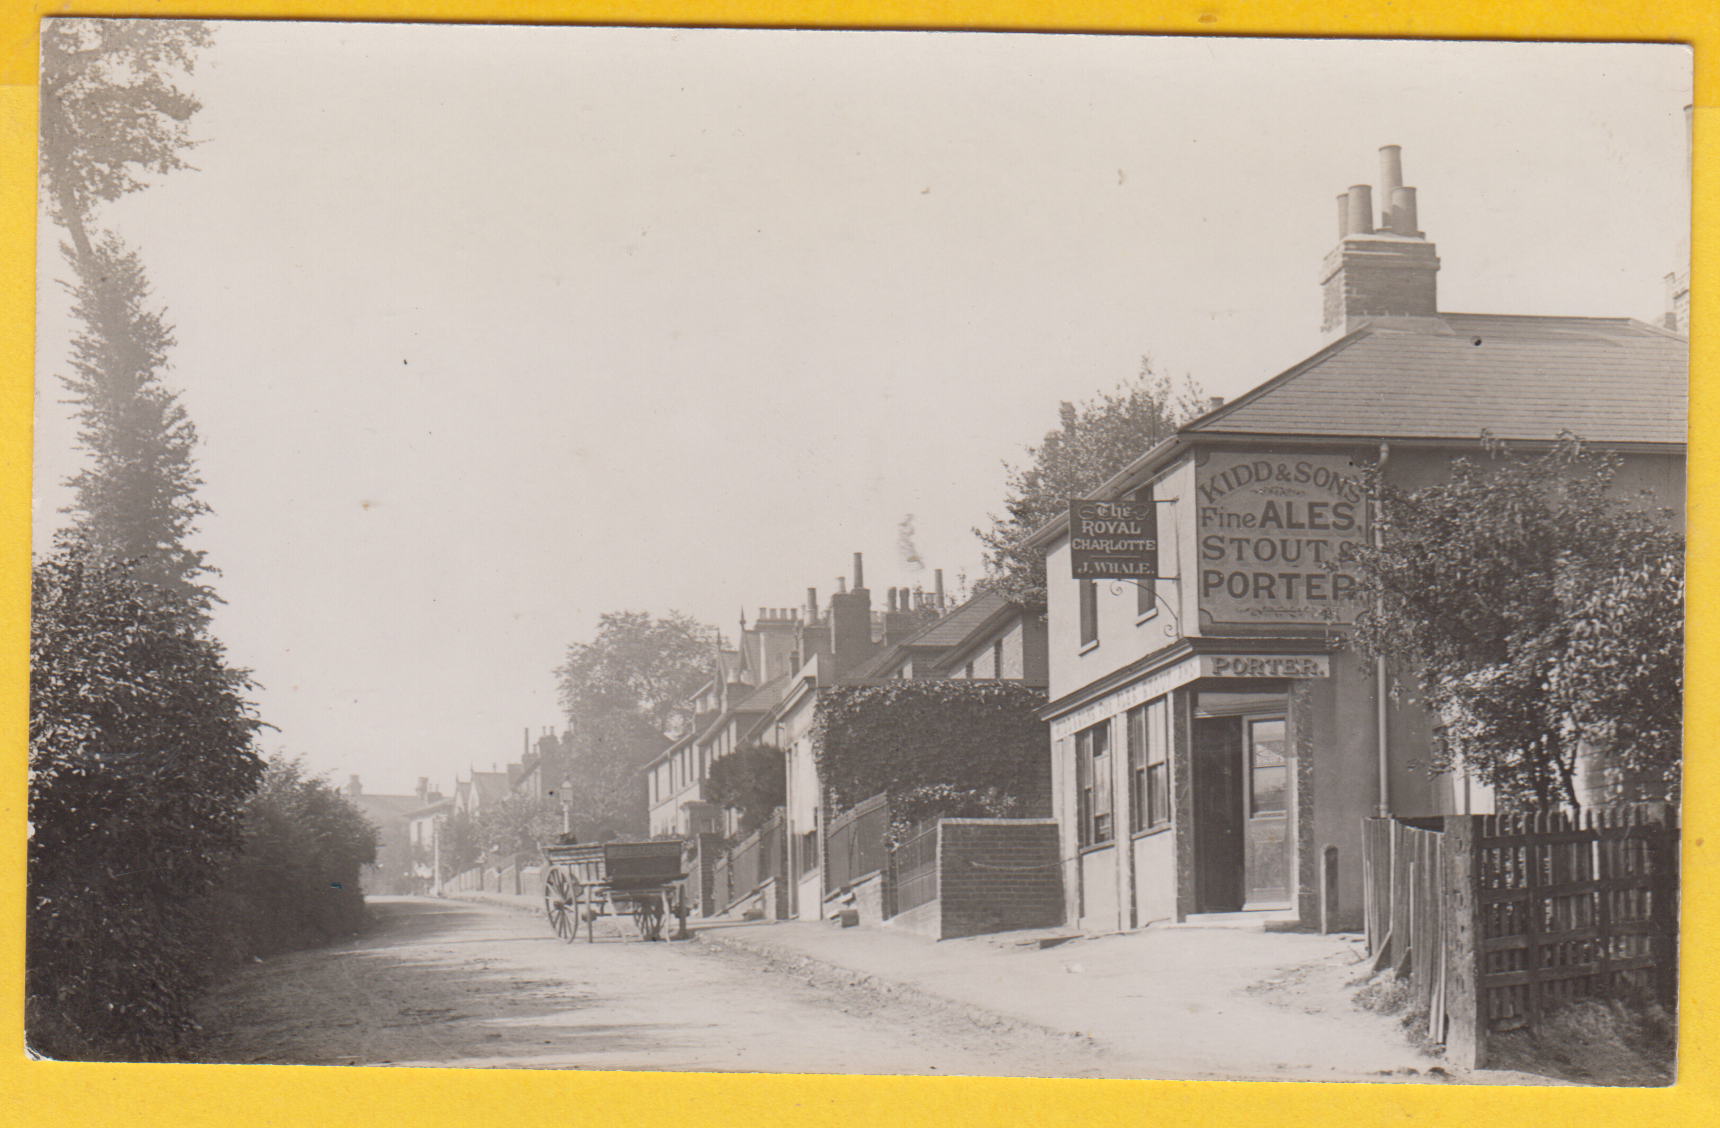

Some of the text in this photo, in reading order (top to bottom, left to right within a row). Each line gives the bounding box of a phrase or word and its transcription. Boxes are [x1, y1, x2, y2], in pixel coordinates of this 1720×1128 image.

[1198, 461, 1272, 504] KIDD
[1095, 502, 1132, 520] The
[1201, 506, 1257, 529] Fine
[1082, 521, 1141, 536] ROYAL
[1072, 539, 1156, 553] CHARLOTTE
[1202, 534, 1329, 563] STOUT
[1078, 562, 1155, 574] J. WHALE.
[1211, 656, 1325, 676] PORTER.
